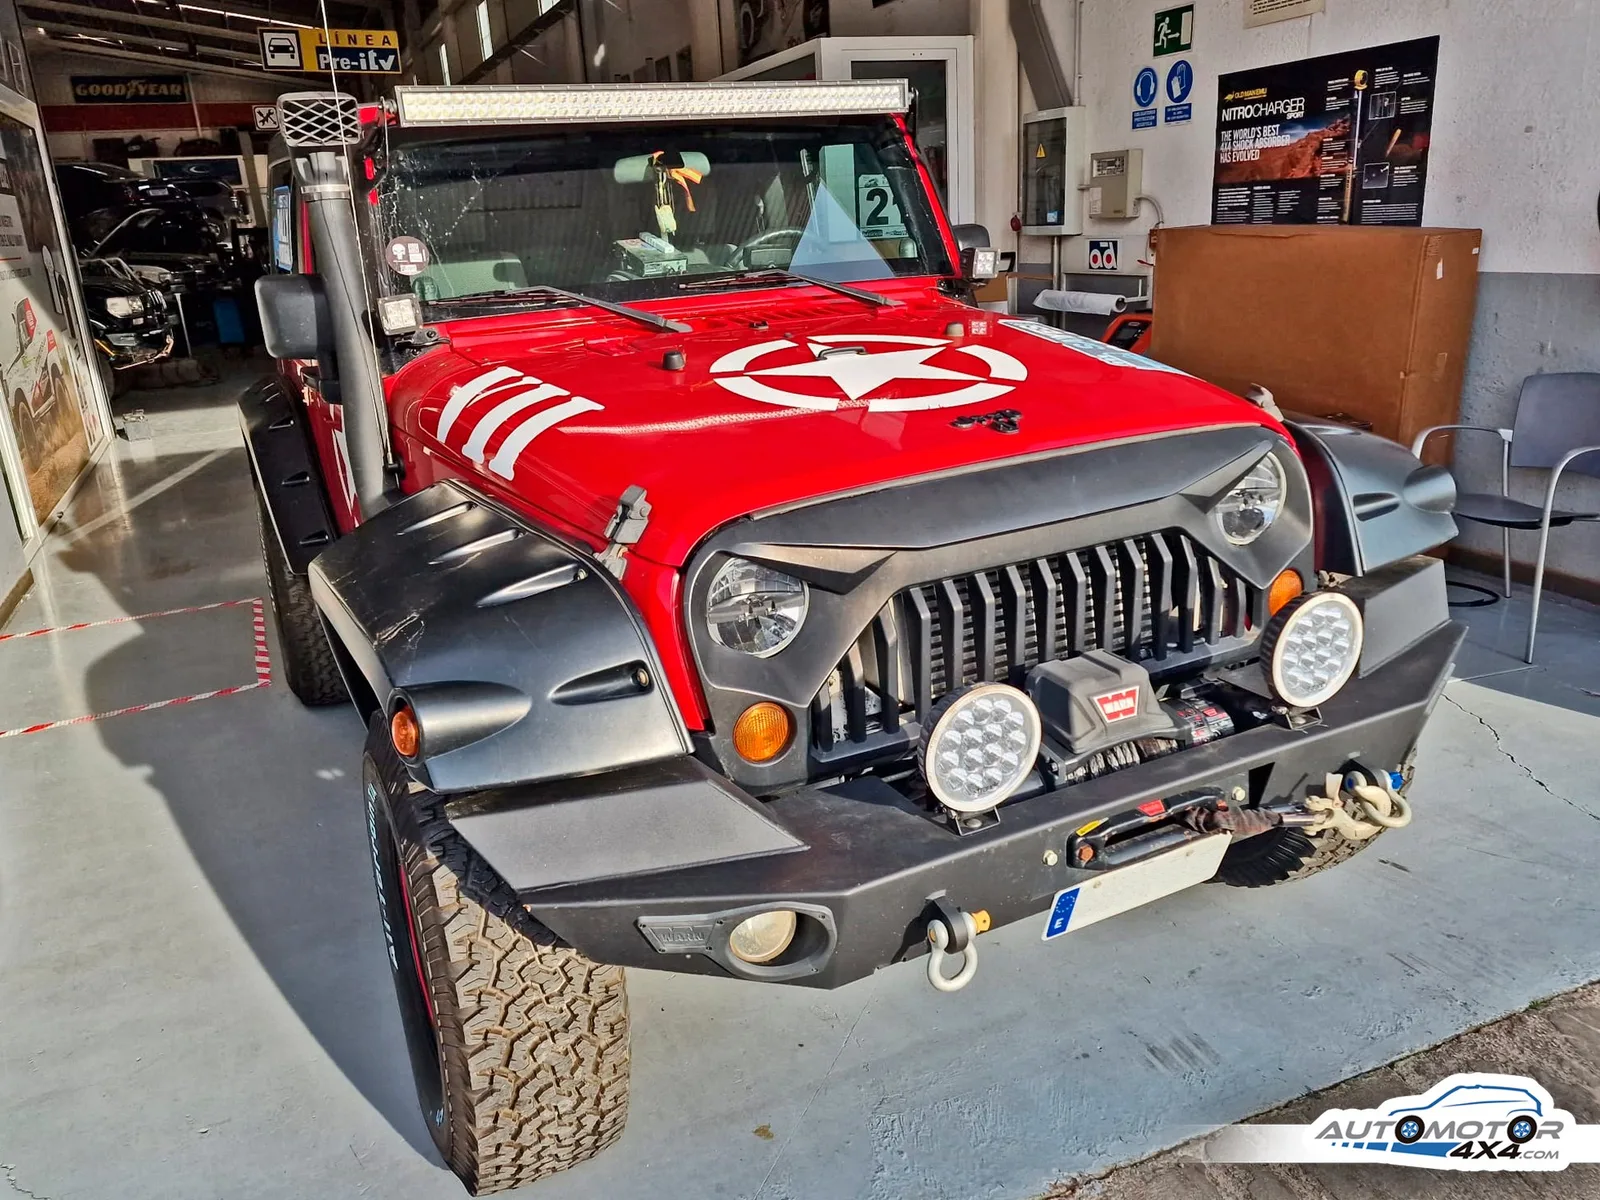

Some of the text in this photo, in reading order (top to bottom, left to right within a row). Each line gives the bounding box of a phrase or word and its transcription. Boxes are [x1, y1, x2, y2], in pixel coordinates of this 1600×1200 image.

[319, 31, 392, 46] LÍNEA
[1221, 97, 1305, 121] NITROCHARGER
[1286, 111, 1304, 120] SPORT
[1221, 124, 1280, 142] THE WORLD'S BEST
[1232, 138, 1255, 151] SHOCK
[1254, 135, 1291, 149] ABSORBER
[1220, 149, 1260, 163] HAS EVOLVED
[1102, 697, 1135, 716] WARN
[1053, 917, 1065, 930] E
